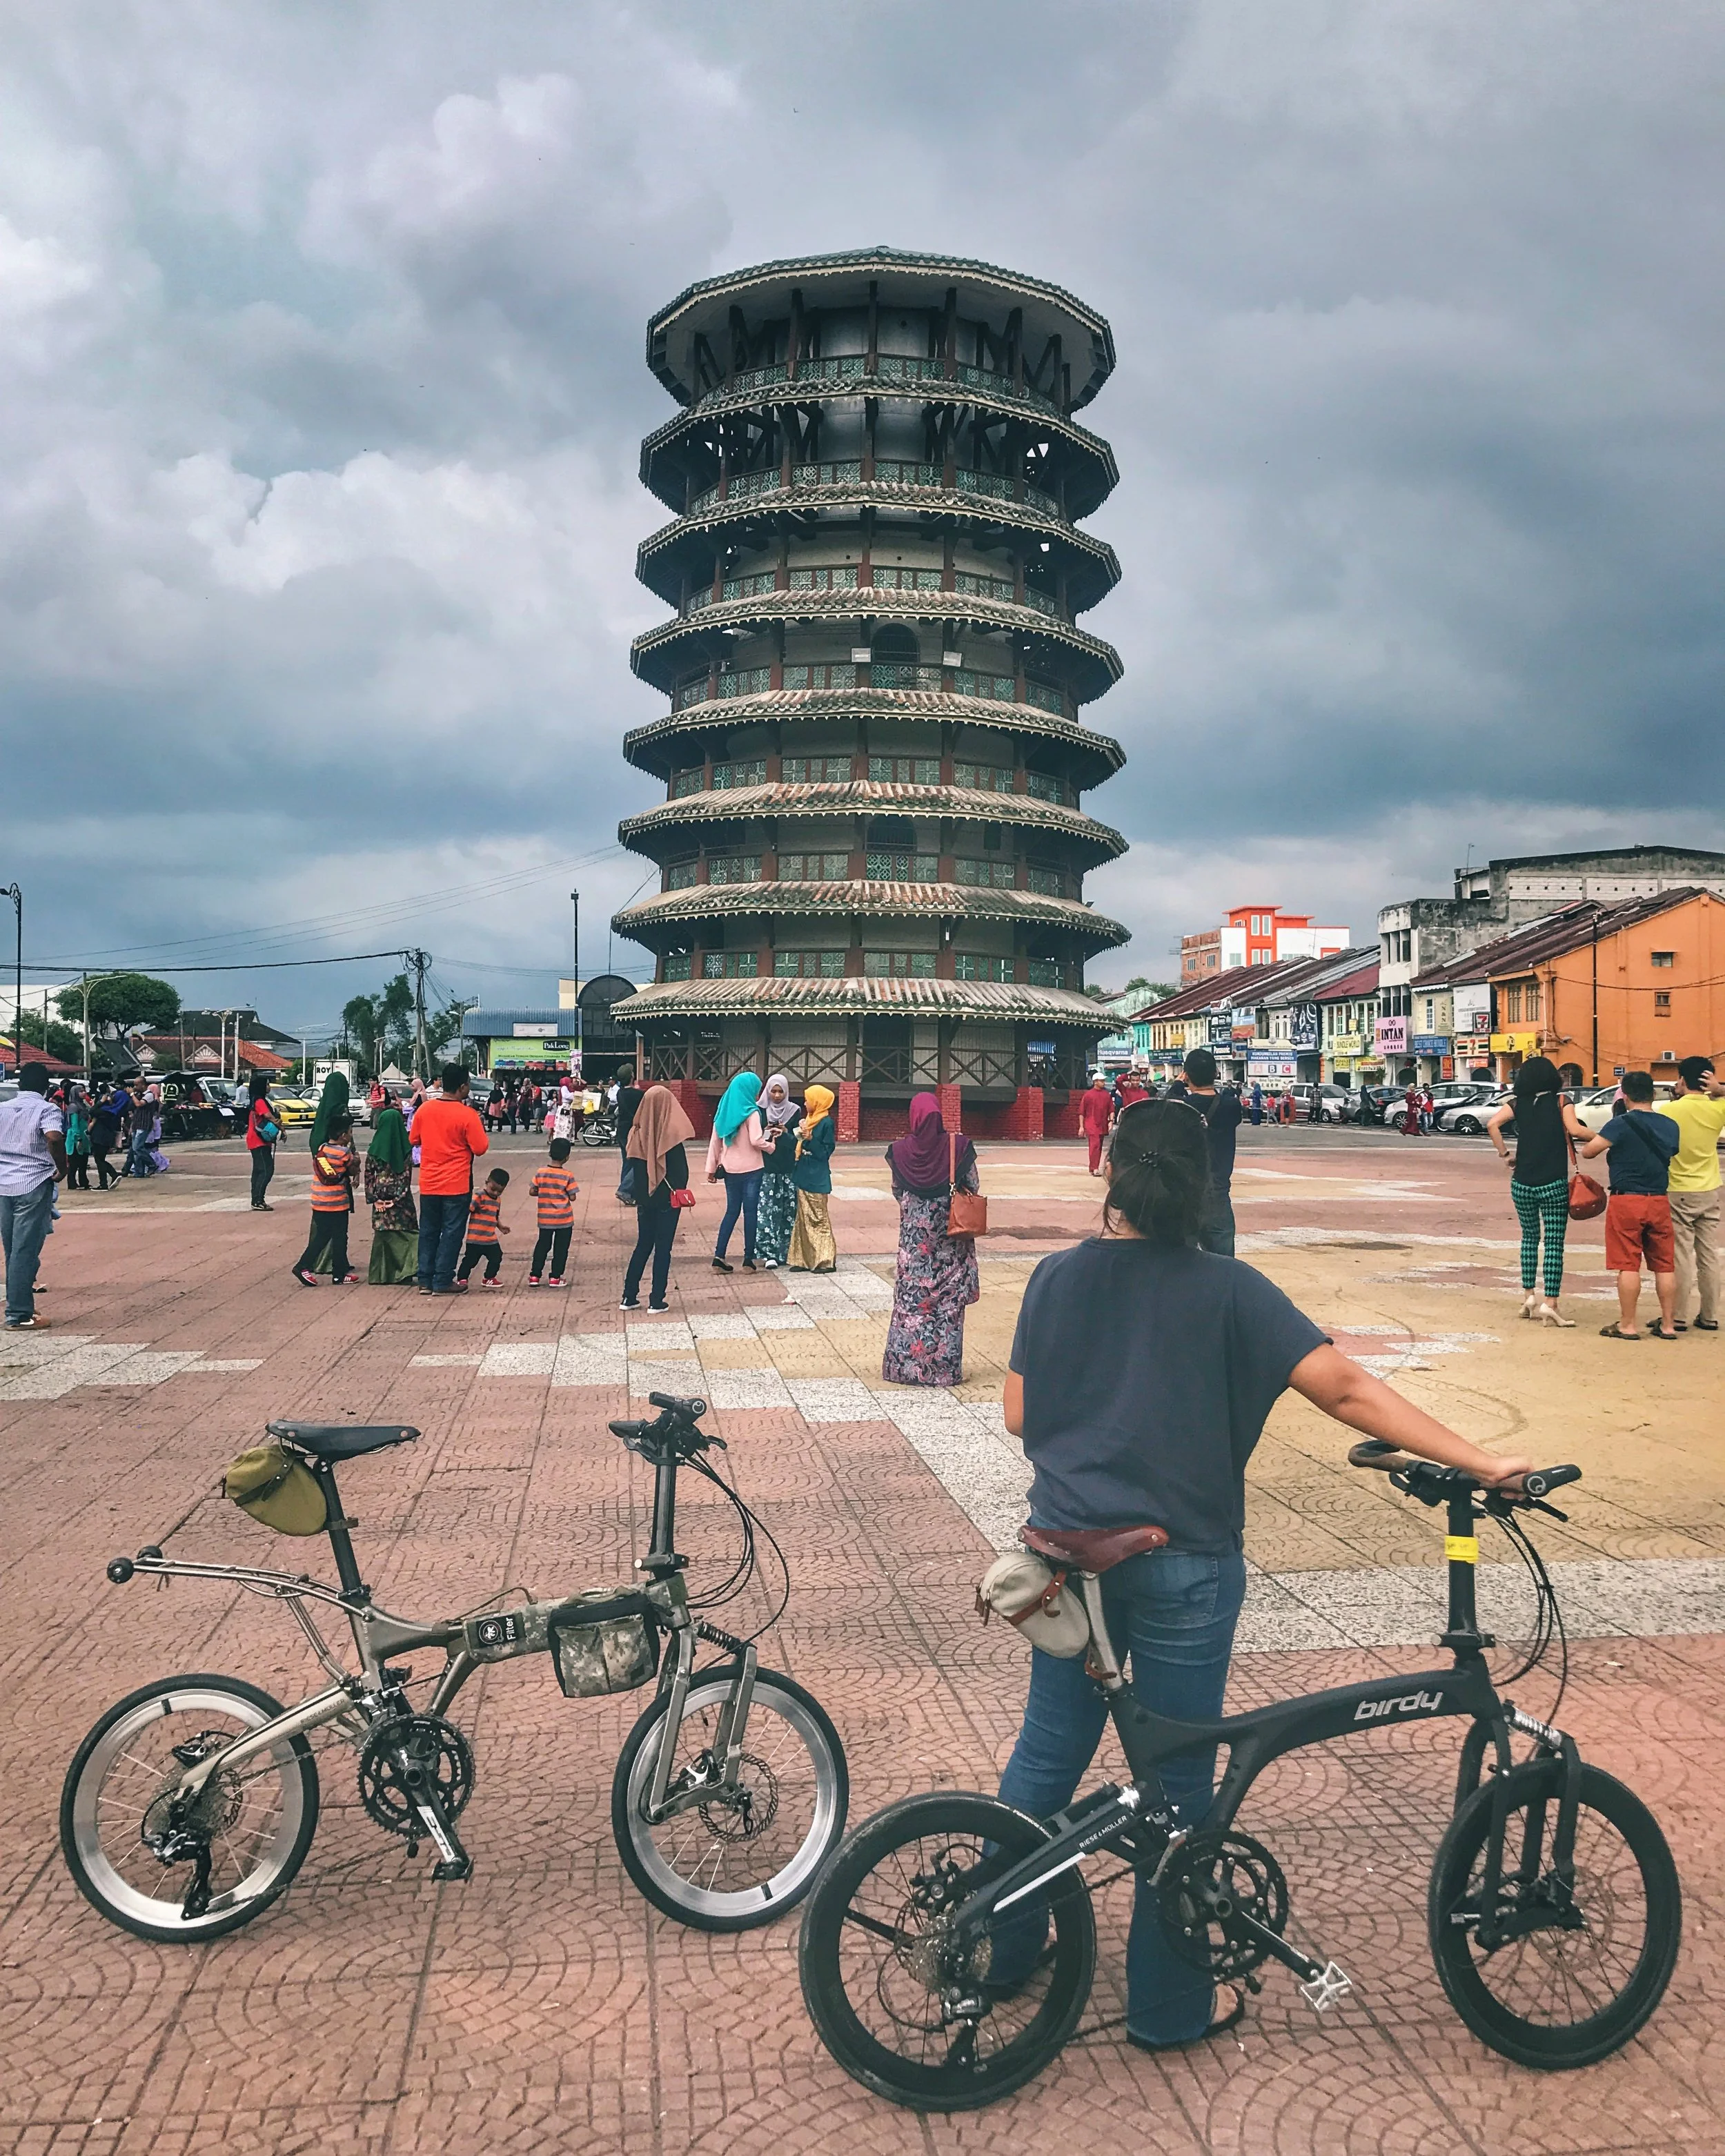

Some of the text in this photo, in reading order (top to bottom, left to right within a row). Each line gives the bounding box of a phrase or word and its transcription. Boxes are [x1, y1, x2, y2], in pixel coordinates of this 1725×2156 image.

[1477, 1016, 1488, 1029] 7
[1381, 1028, 1403, 1040] INTAN
[1470, 1039, 1476, 1055] 7
[317, 1157, 337, 1176] NIKE
[506, 1617, 516, 1640] Filter
[1354, 1690, 1443, 1720] birdy
[1078, 1833, 1098, 1849] RIESE
